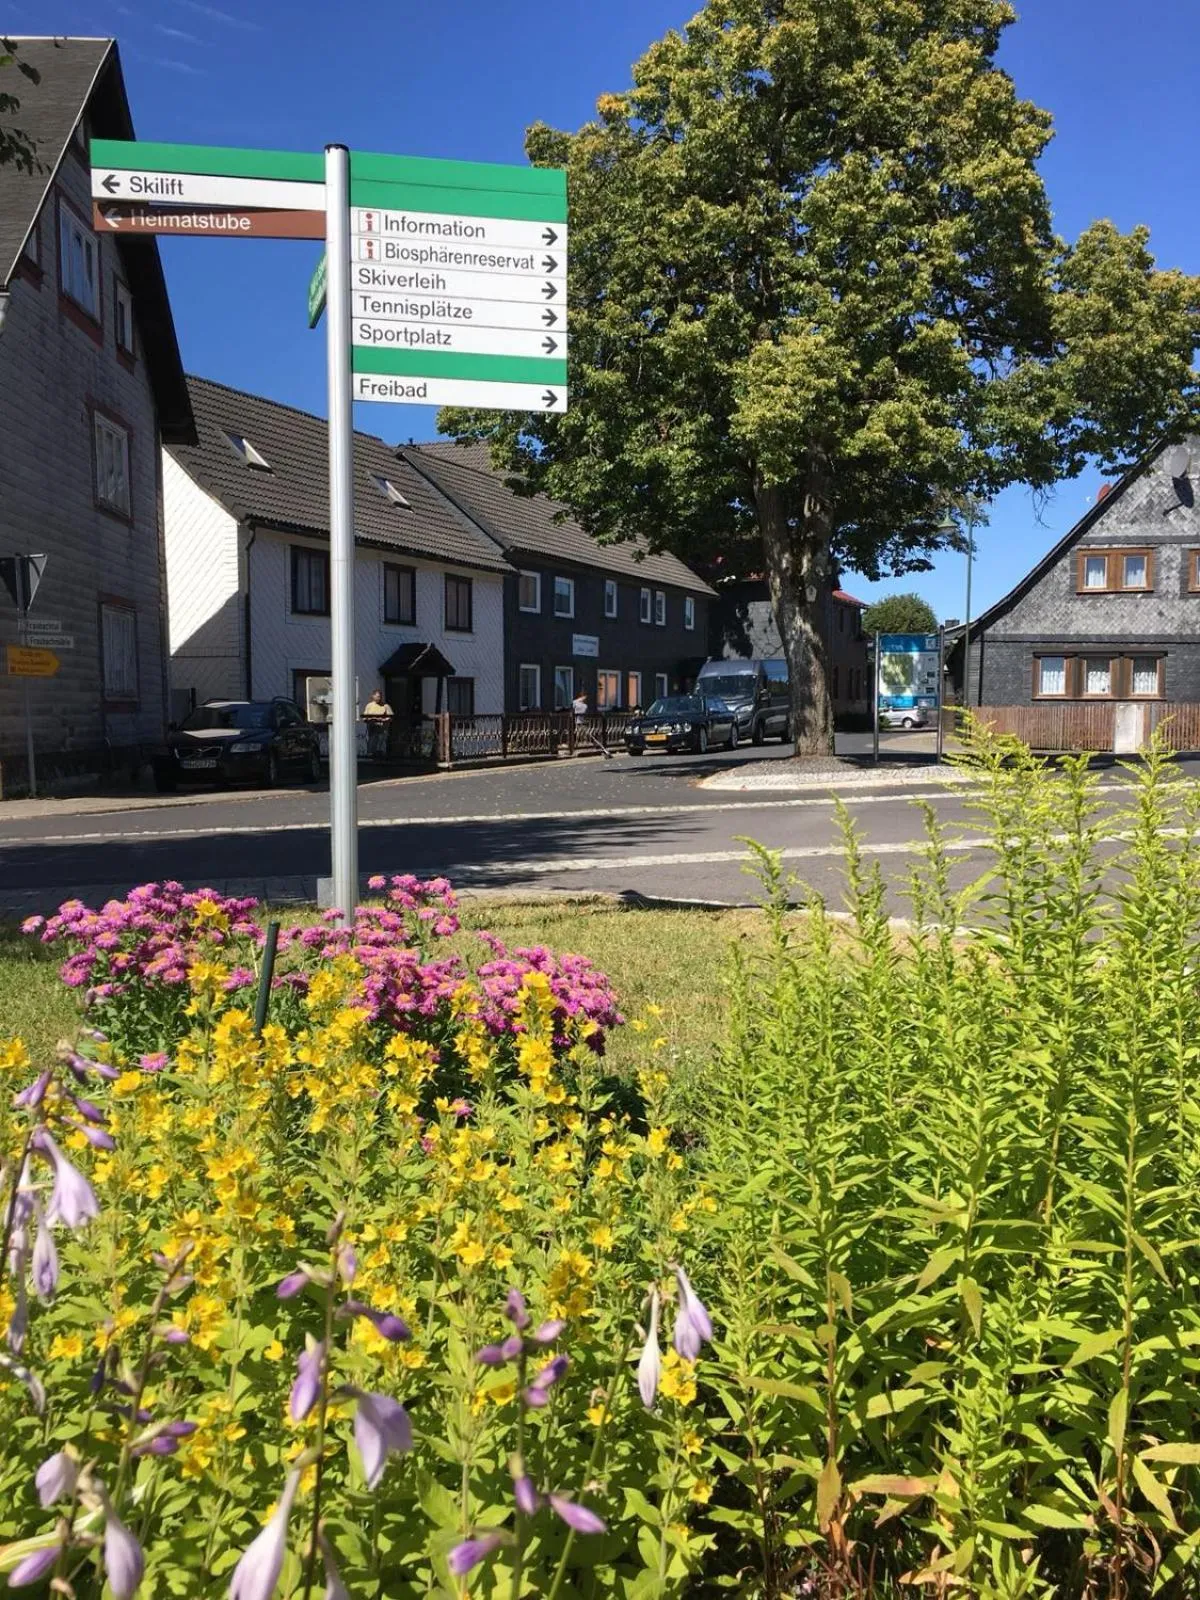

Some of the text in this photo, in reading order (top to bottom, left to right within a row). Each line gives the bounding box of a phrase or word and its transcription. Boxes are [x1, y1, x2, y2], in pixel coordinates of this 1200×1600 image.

[129, 176, 184, 196] Skilift
[130, 208, 252, 230] Heimatstube
[384, 214, 486, 239] Information
[384, 242, 535, 270] Biosphärenreservat
[358, 267, 446, 290] Skiverleih
[359, 295, 473, 319] Tennisplätze
[359, 323, 453, 346] Sportplatz
[359, 378, 428, 398] Freibad
